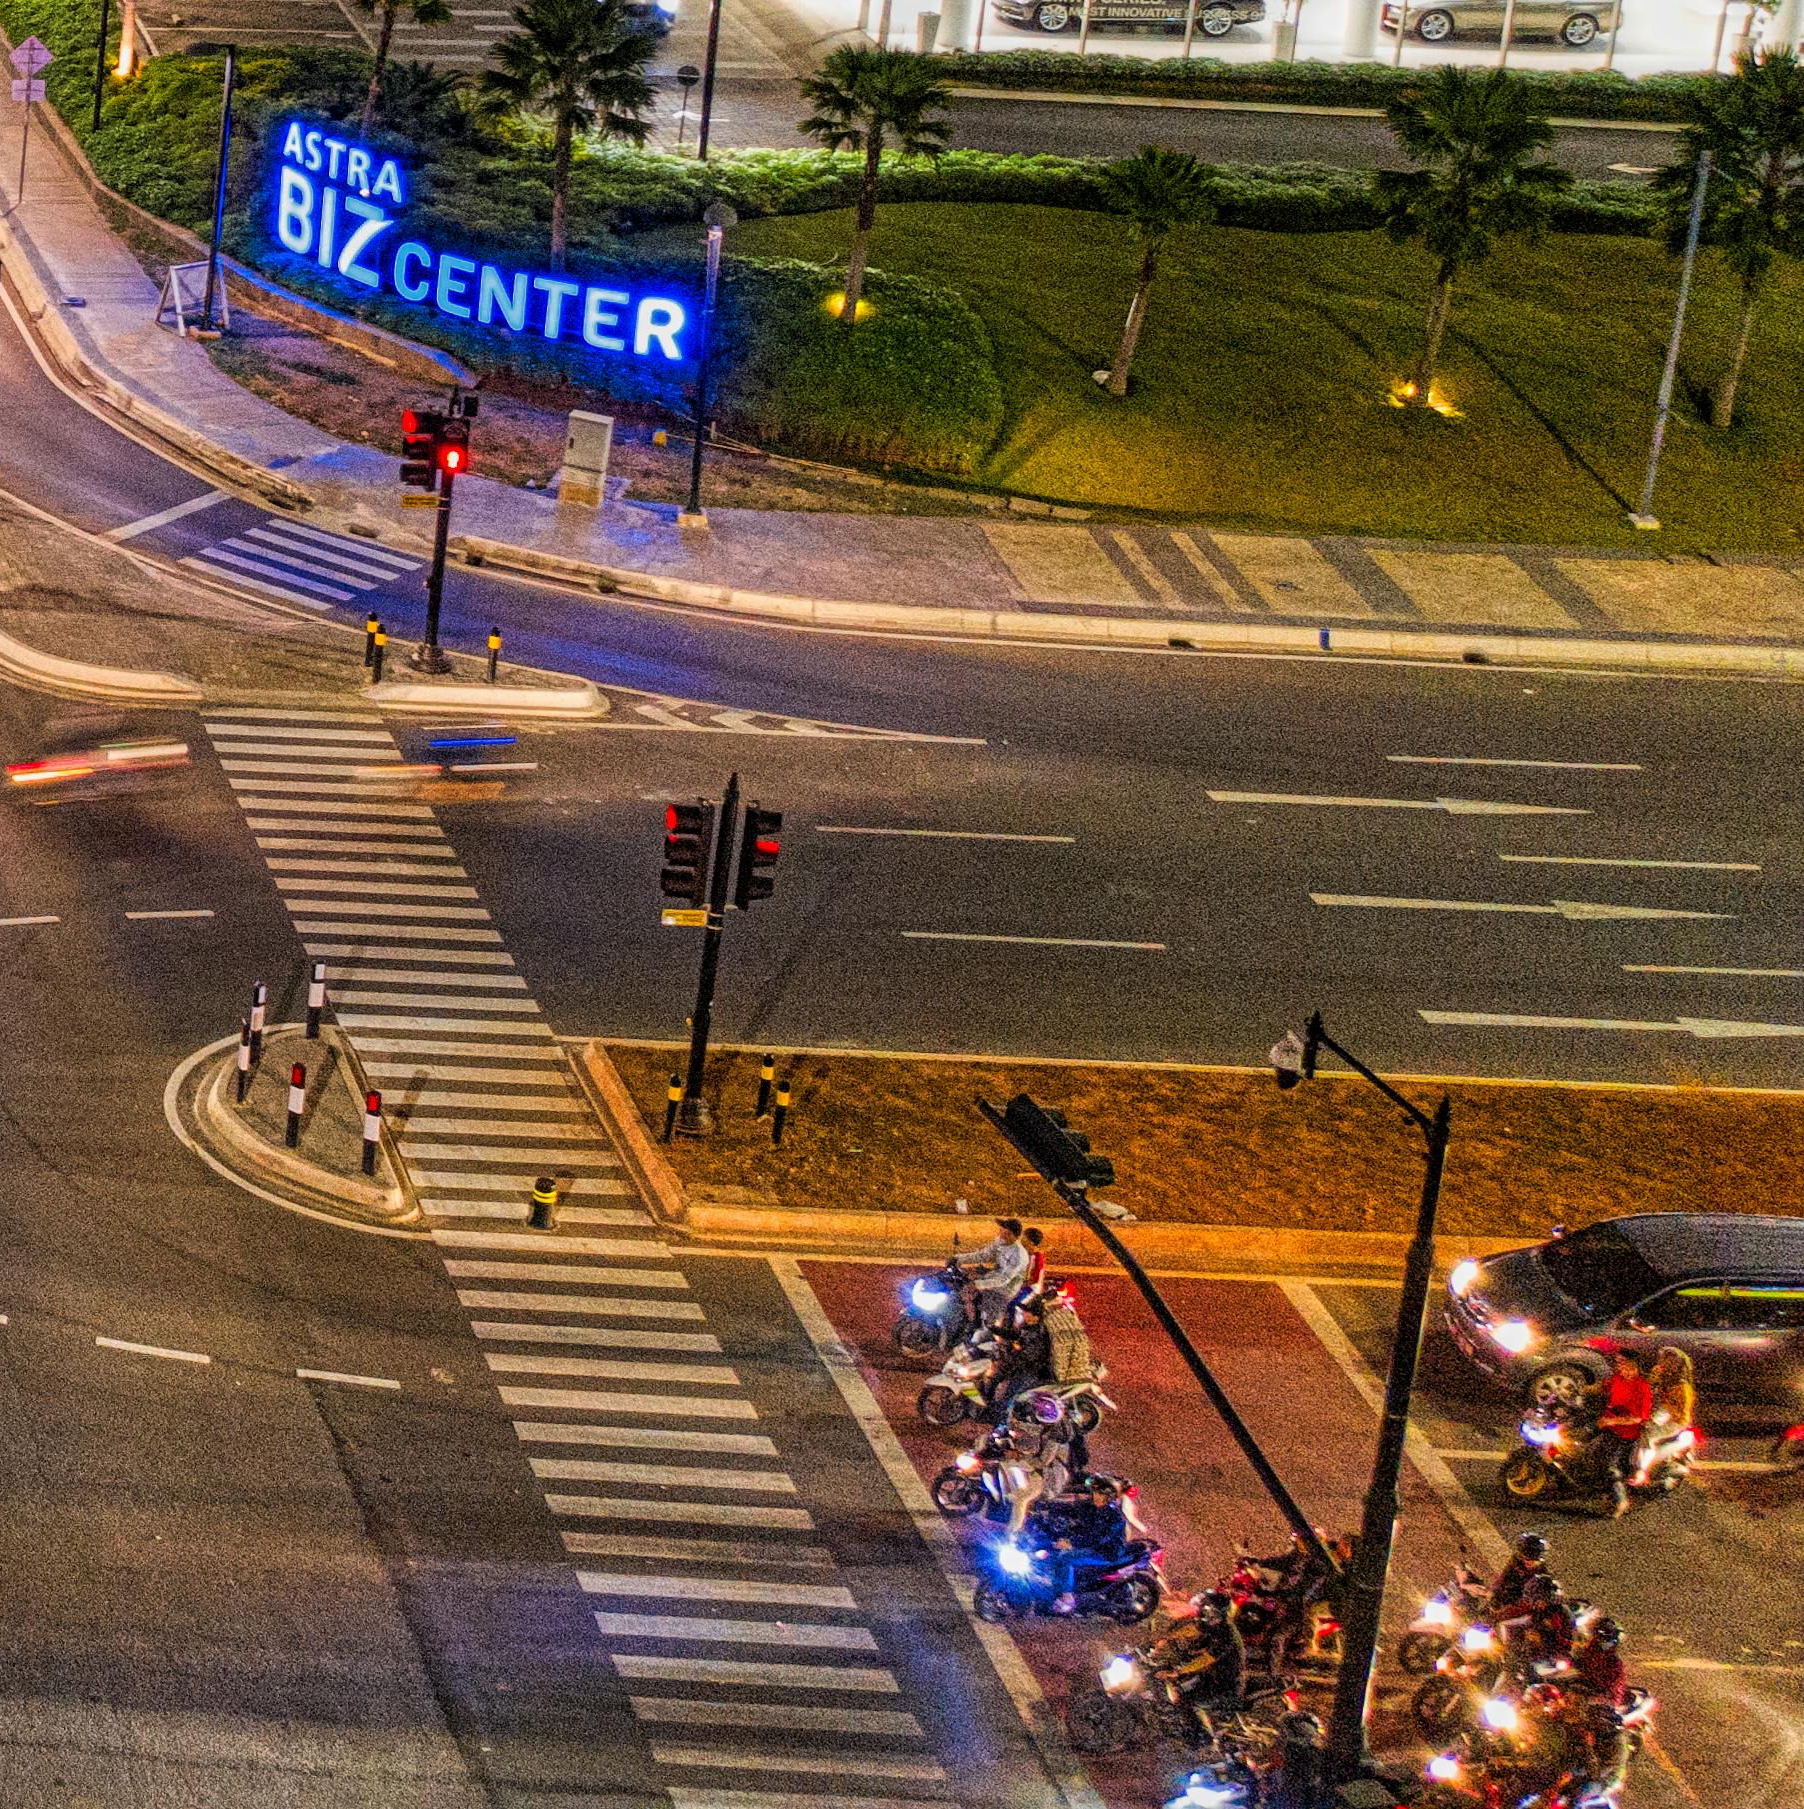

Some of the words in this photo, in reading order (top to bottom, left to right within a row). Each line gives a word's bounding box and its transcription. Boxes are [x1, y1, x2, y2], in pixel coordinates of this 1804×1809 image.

[1068, 6, 1107, 17] MST
[1108, 7, 1182, 18] INNOVATIVE
[282, 121, 403, 204] ASTRA
[278, 164, 393, 289] BIZ
[393, 241, 687, 362] CENTER
